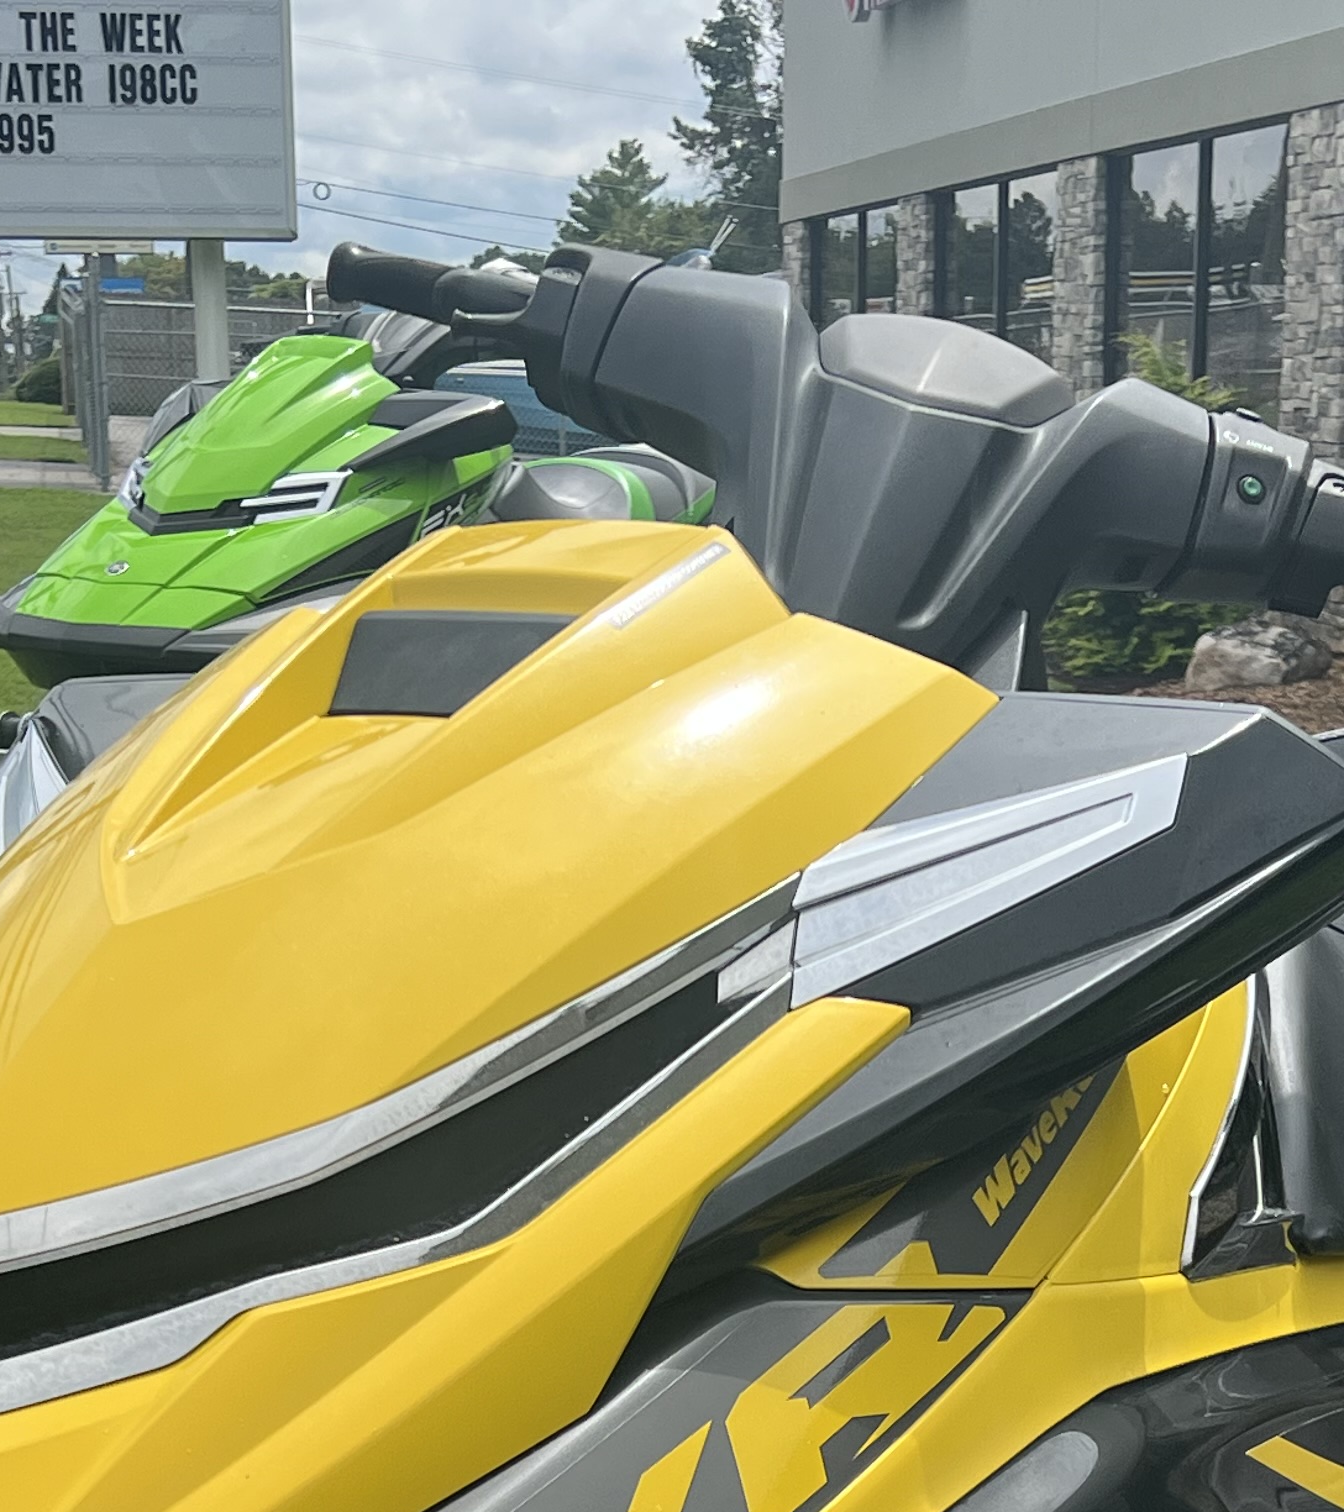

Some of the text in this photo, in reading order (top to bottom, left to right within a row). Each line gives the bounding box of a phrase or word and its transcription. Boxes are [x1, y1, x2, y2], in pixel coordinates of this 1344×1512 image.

[19, 11, 77, 54] THE
[100, 12, 184, 55] WEEK
[971, 1075, 1095, 1228] WaveR
